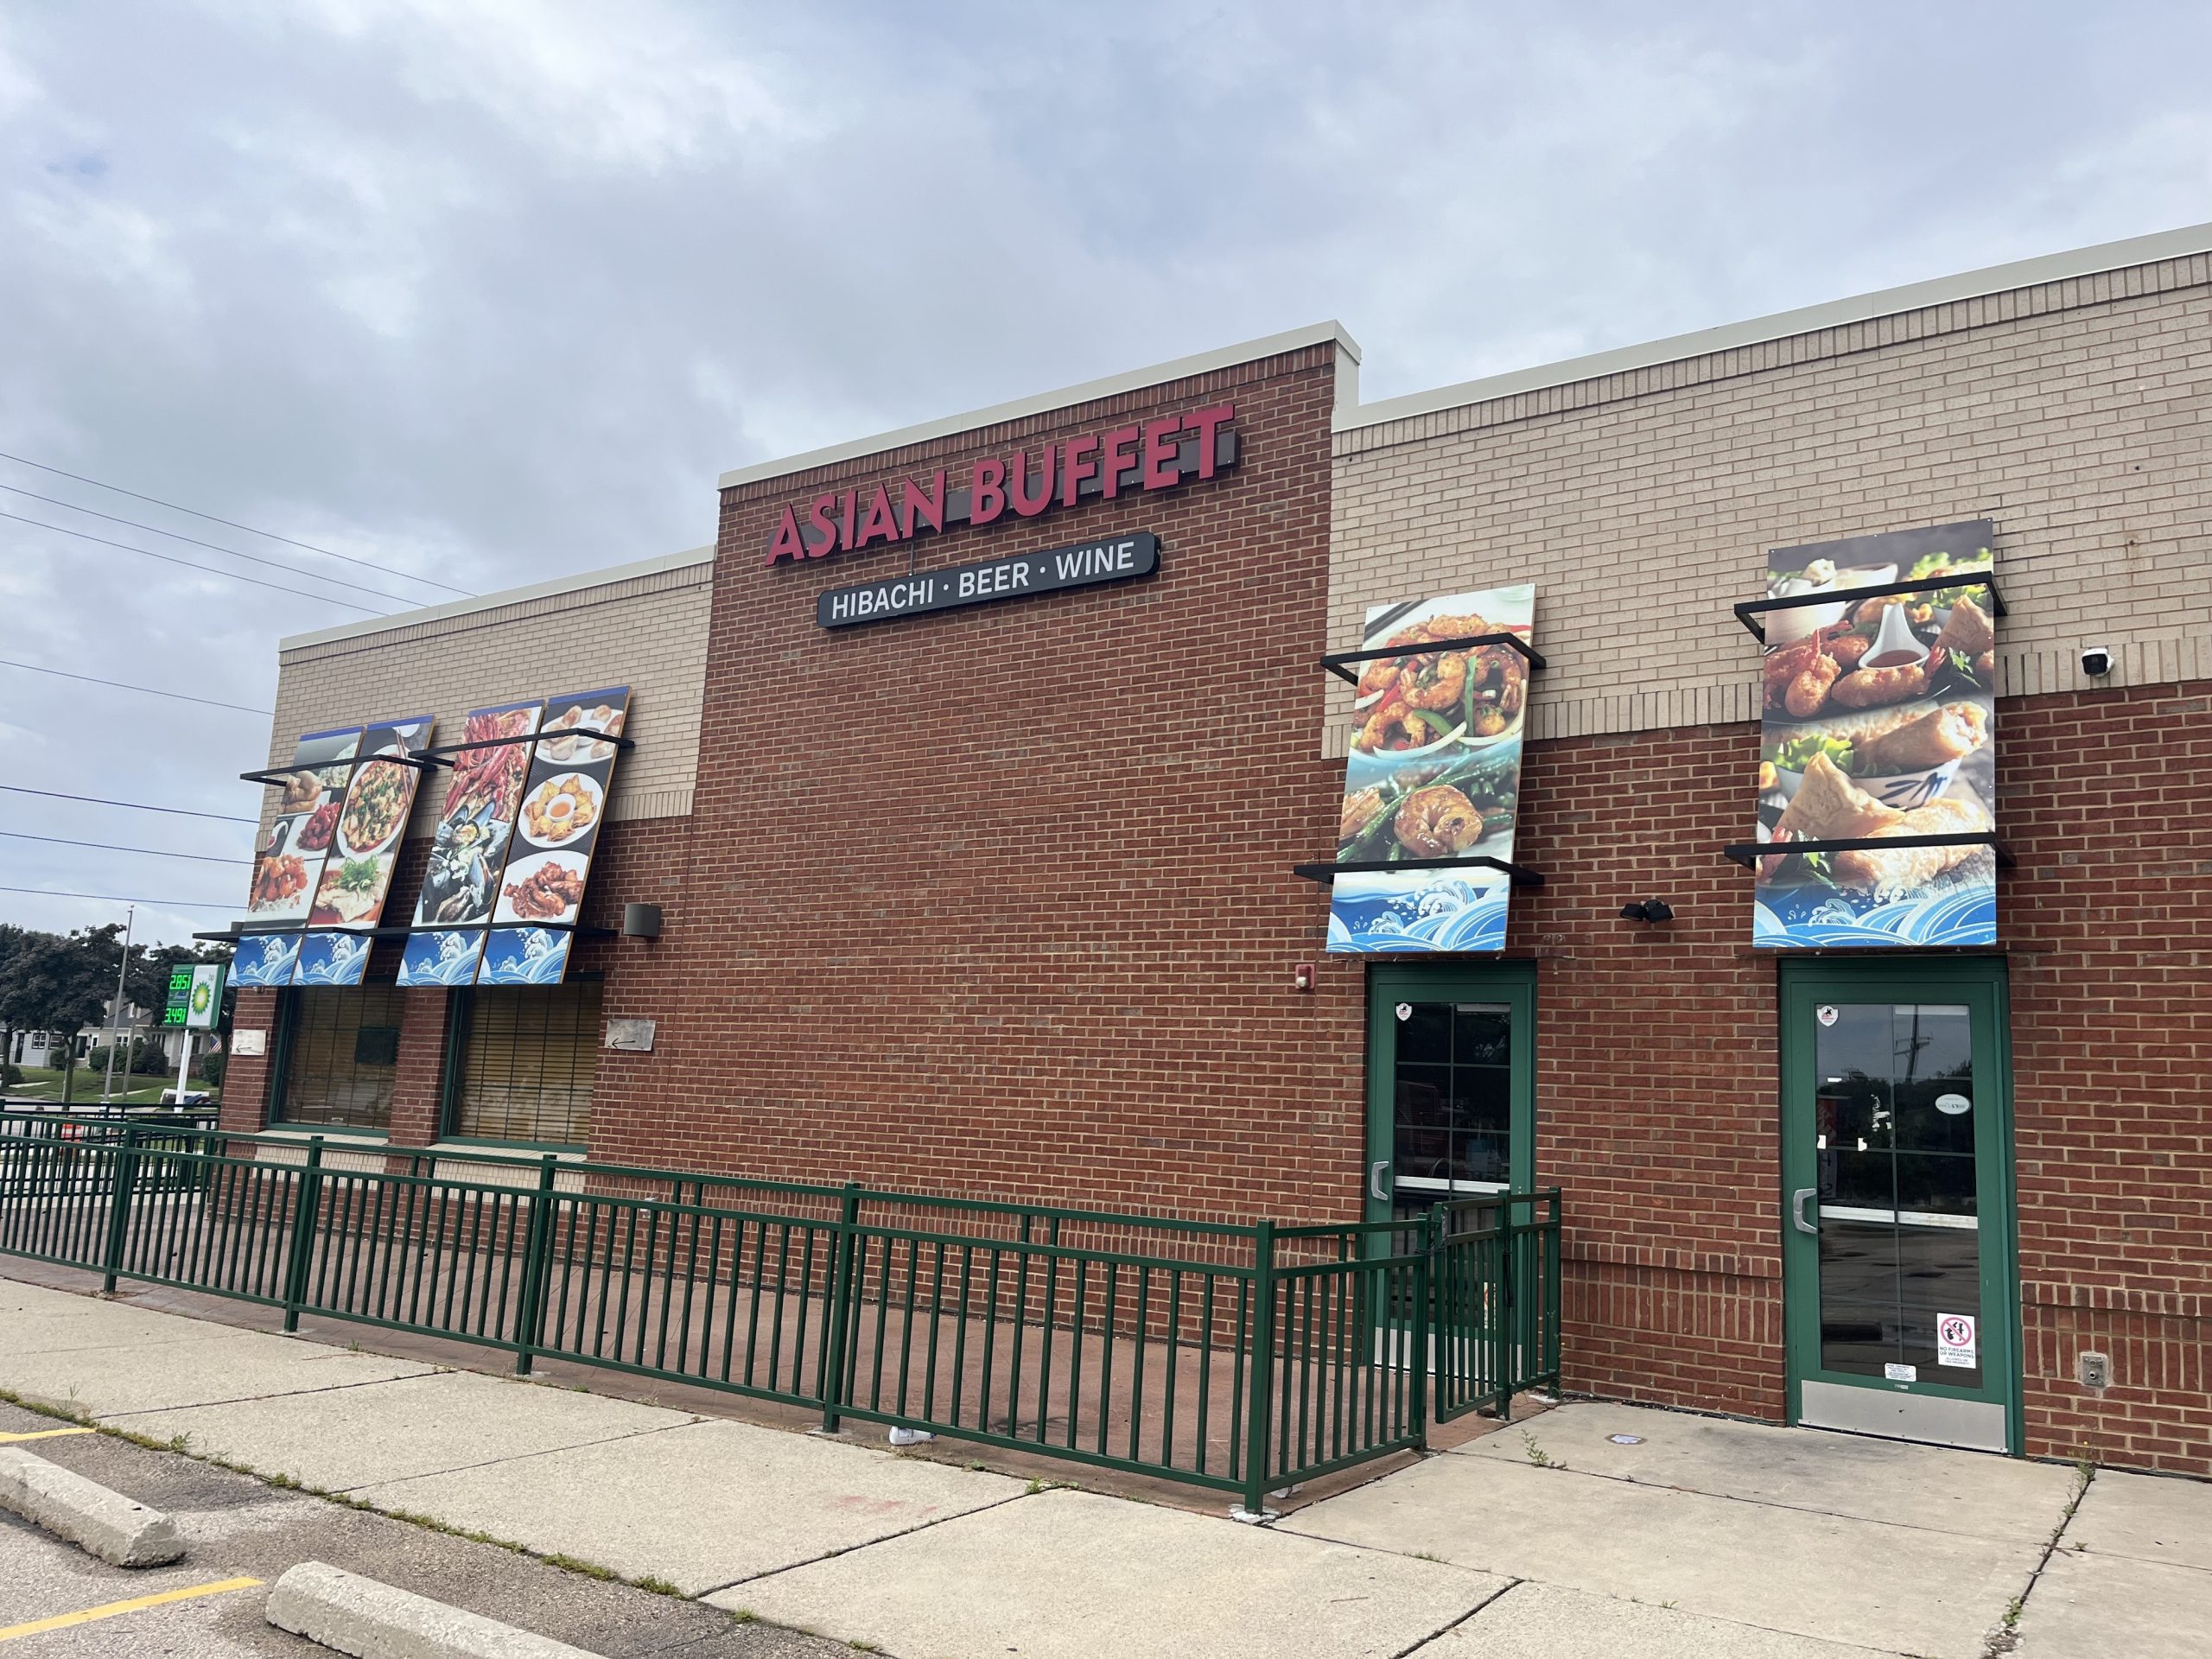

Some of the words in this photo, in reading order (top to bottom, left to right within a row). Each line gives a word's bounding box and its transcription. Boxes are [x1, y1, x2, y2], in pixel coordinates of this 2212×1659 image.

[764, 470, 946, 567] ASIAN
[970, 404, 1235, 524] BUFFET
[831, 579, 934, 620] HIBACHI
[958, 562, 1029, 598] BEER
[1055, 541, 1135, 580] WINE
